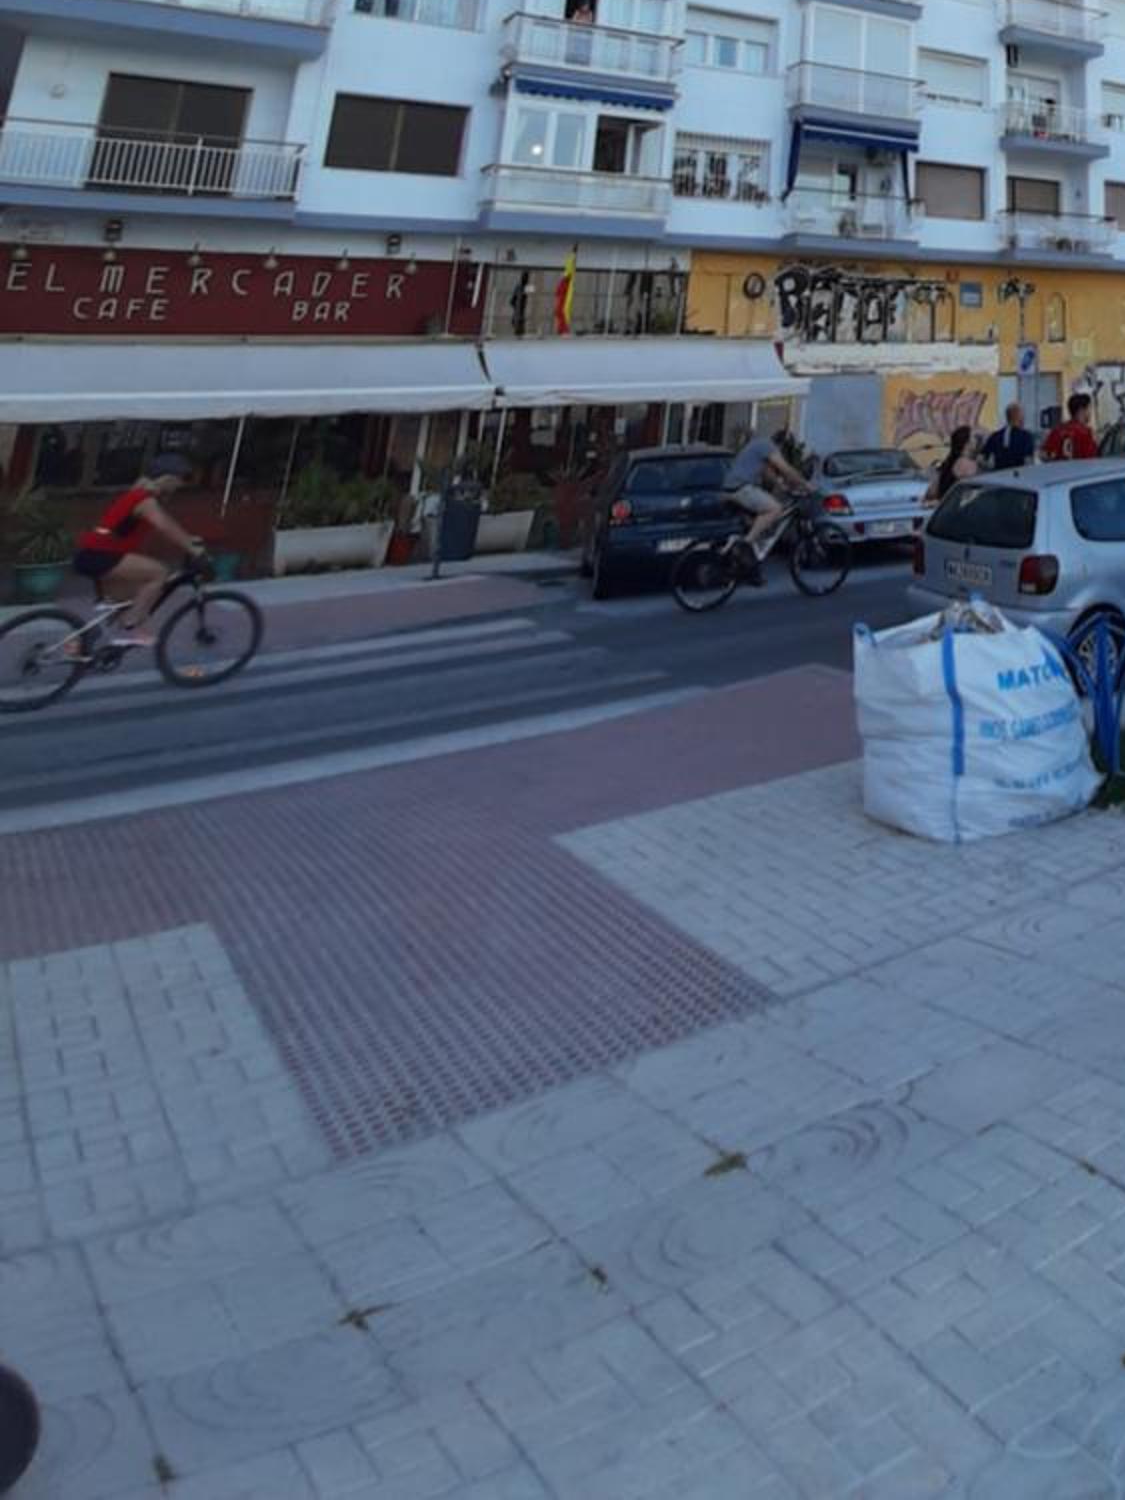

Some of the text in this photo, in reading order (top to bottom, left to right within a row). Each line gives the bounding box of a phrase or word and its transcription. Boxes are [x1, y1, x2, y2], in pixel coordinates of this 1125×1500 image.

[6, 262, 405, 299] EL MERCADER
[73, 297, 350, 322] CAFE BAR
